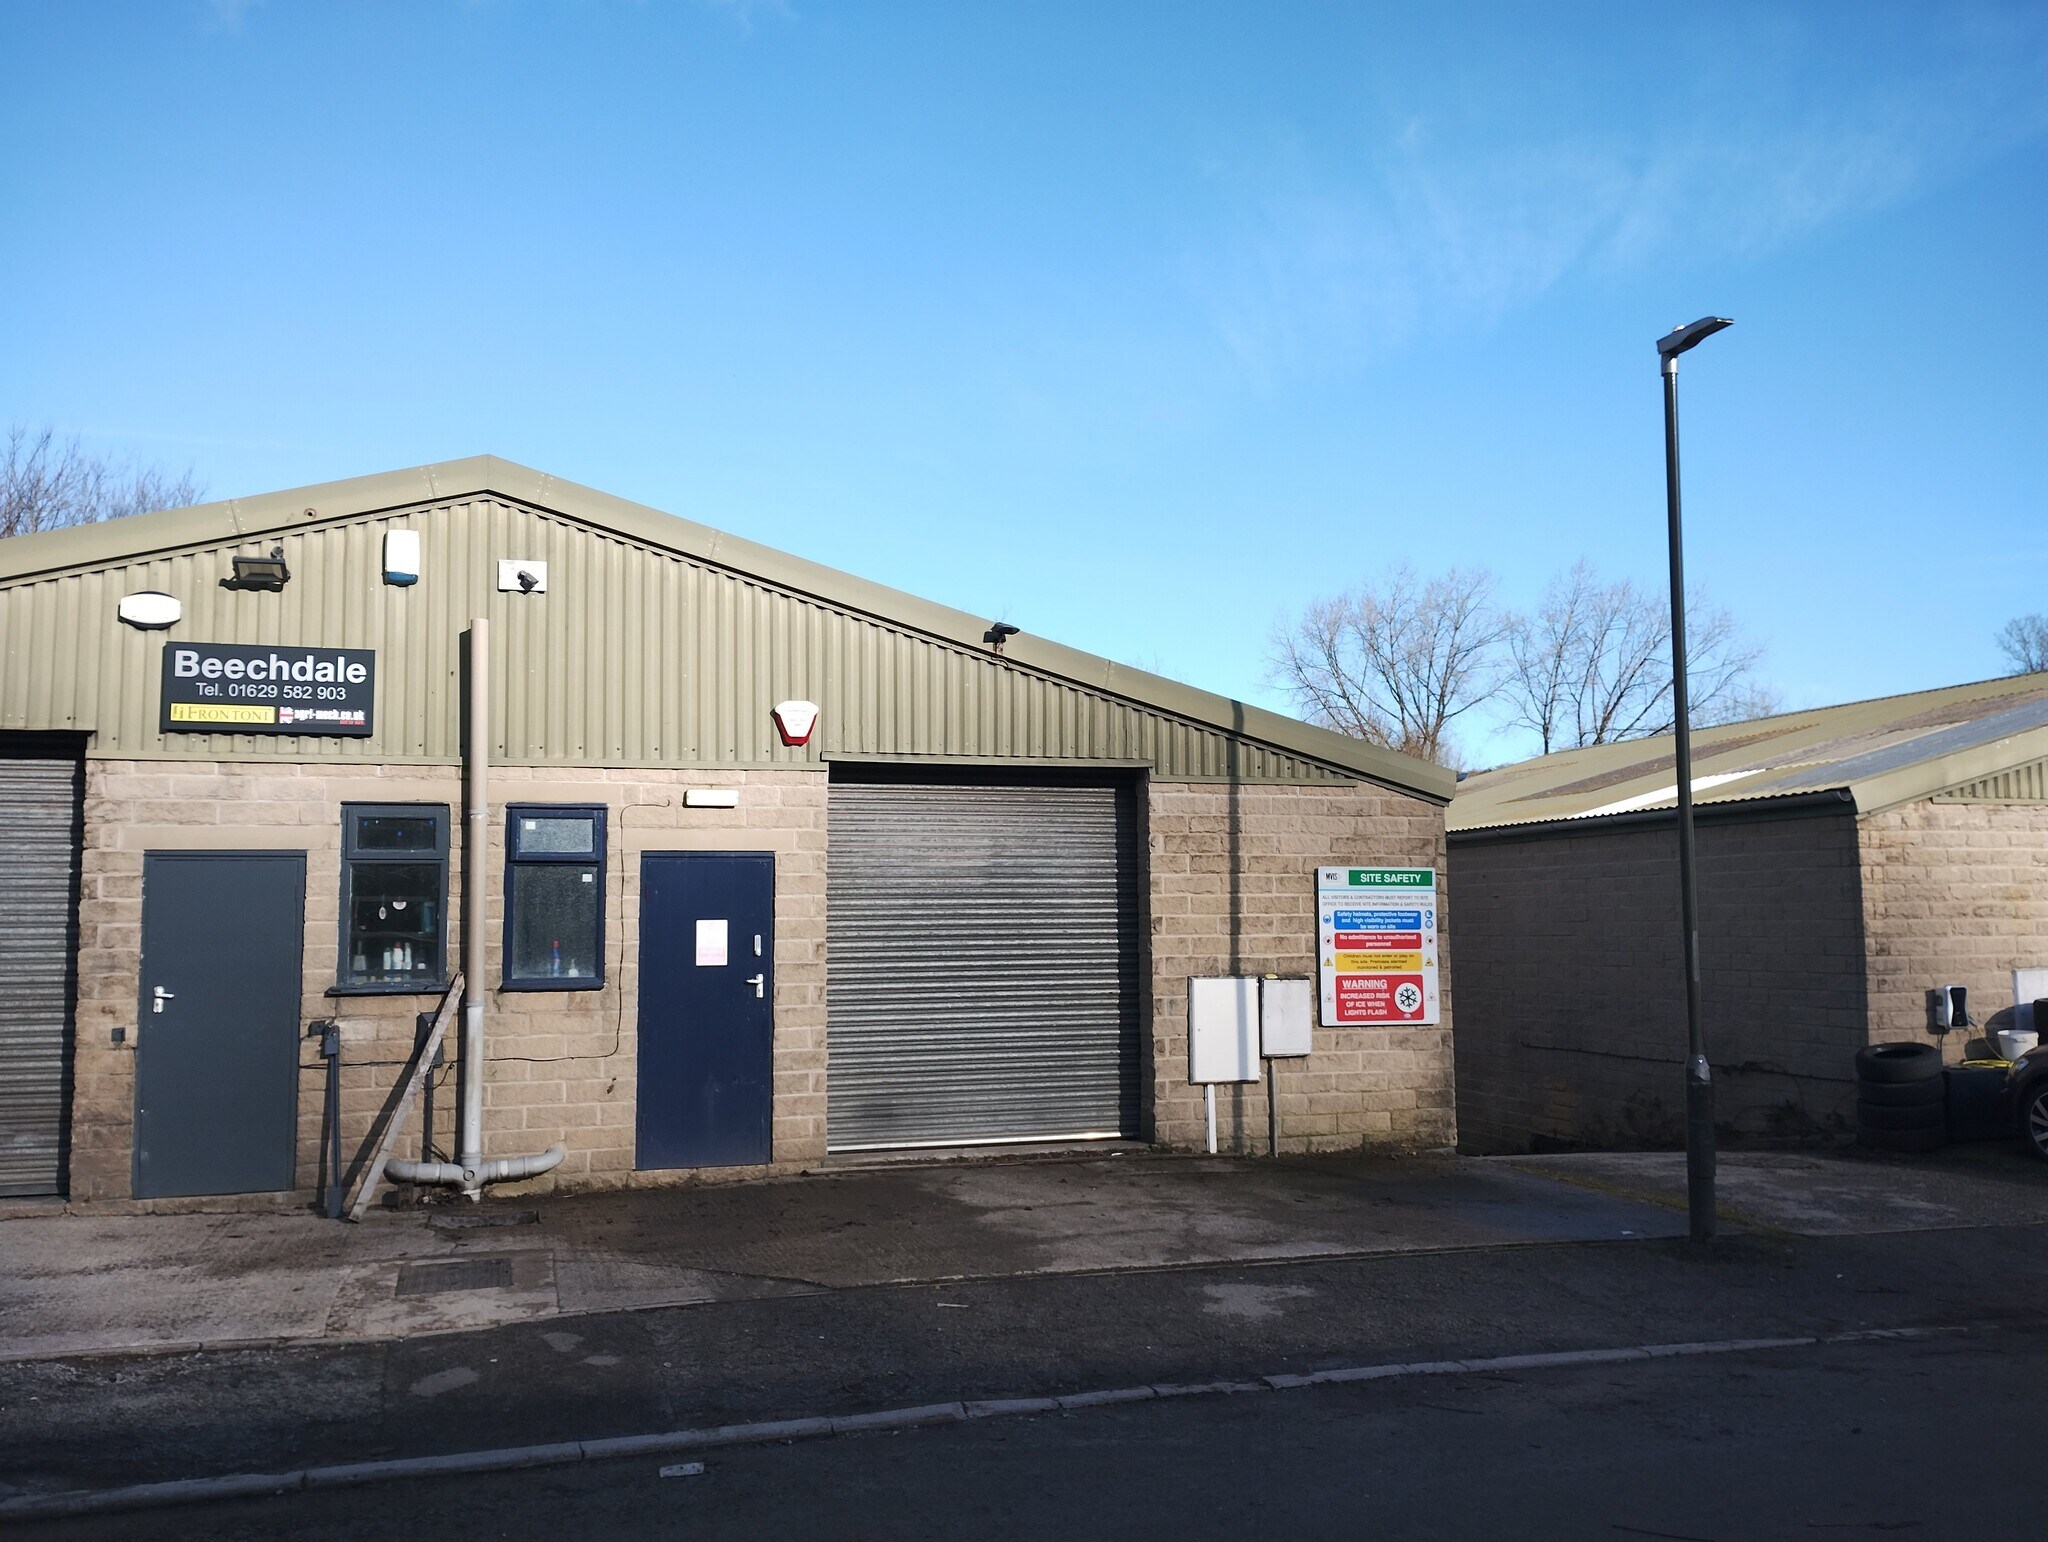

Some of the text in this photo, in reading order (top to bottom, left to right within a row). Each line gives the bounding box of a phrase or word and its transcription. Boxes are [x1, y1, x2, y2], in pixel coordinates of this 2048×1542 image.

[174, 650, 367, 683] Beechdale
[196, 683, 346, 700] Tel. 01629 582 903
[188, 706, 267, 720] FRONTONI
[1360, 874, 1421, 883] SITE SAFETY
[1342, 980, 1387, 989] WARNING
